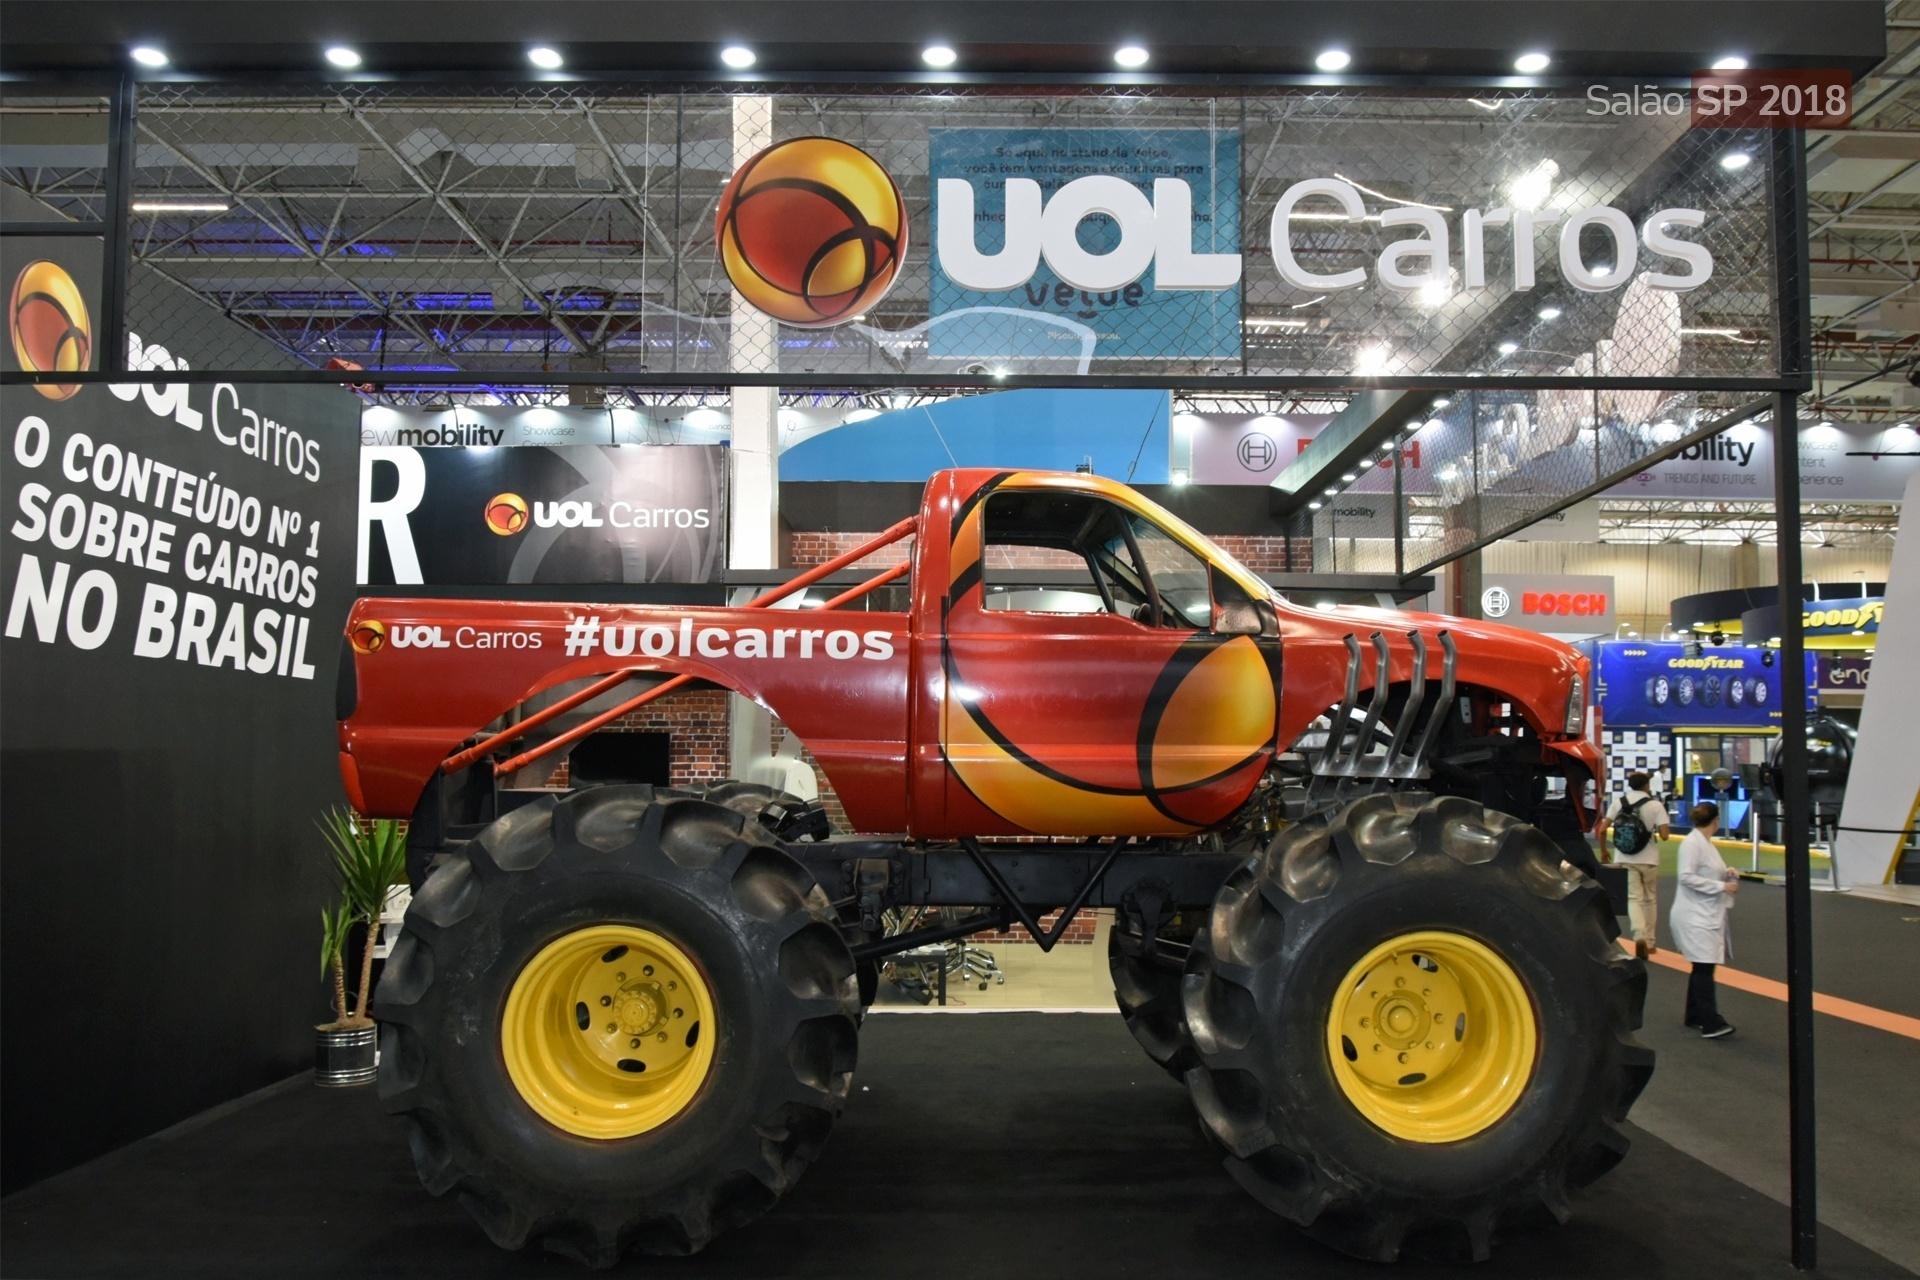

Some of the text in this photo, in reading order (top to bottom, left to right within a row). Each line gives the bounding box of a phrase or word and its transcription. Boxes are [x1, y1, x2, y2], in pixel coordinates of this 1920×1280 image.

[938, 175, 1713, 292] UOL Carros
[211, 382, 321, 482] Carros
[523, 424, 576, 438] Showcase
[14, 416, 50, 468] O
[62, 432, 261, 537] CONTEÚDO
[305, 520, 320, 558] 1
[1664, 472, 1757, 485] TRENDS AND FUTURE
[534, 501, 710, 529] UOL Carros
[11, 482, 319, 608] SOBRE CARROS
[5, 553, 316, 680] NO BRASIL
[1521, 591, 1607, 617] BOSCH
[390, 625, 542, 650] UOL Carros
[564, 616, 895, 660] #uolcarros
[1668, 655, 1744, 671] GOODYEAR
